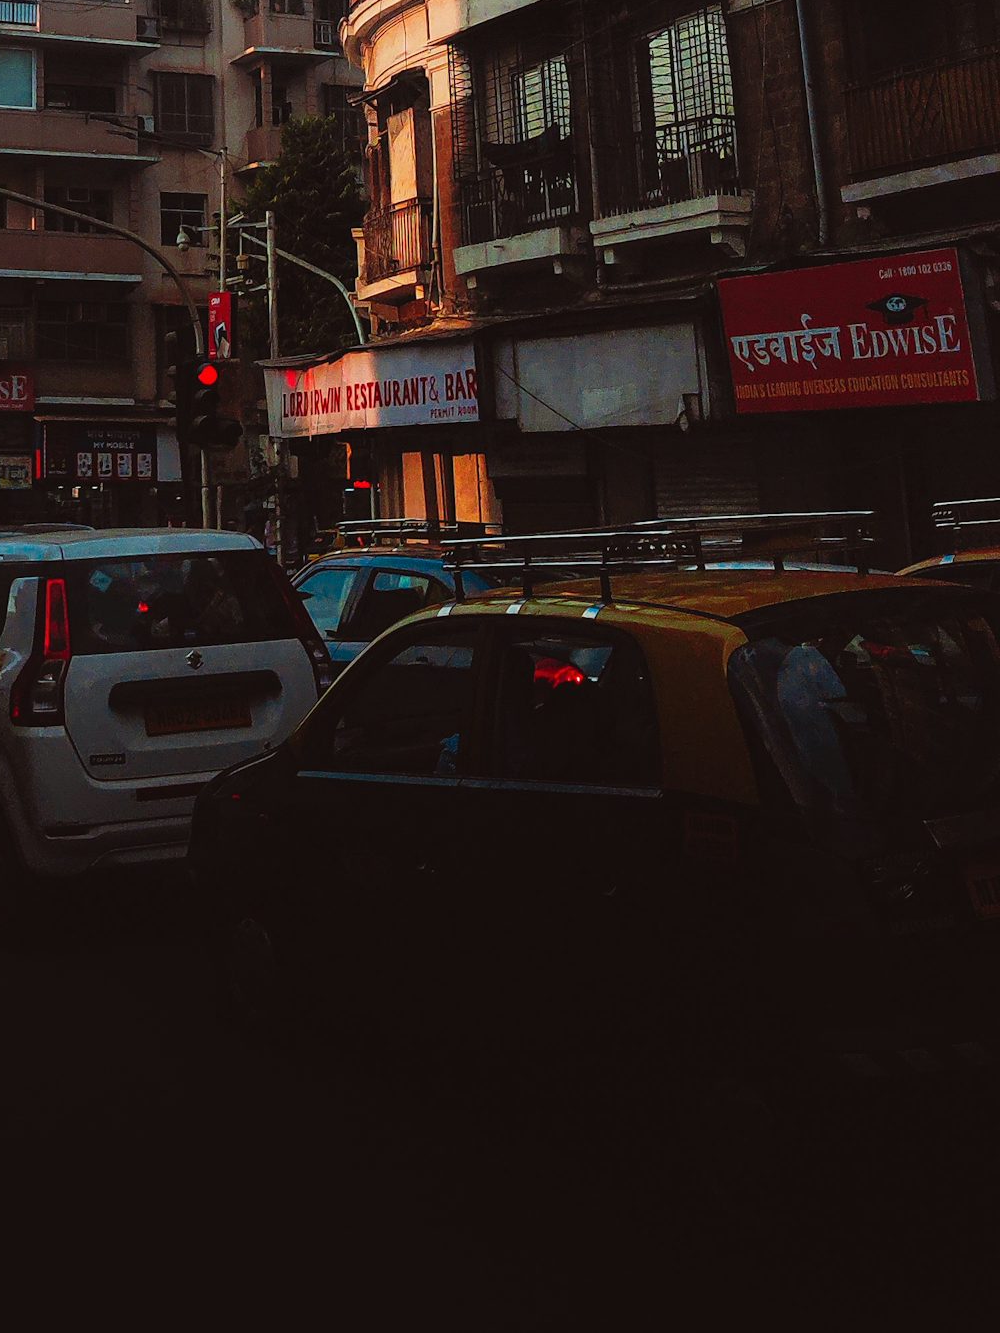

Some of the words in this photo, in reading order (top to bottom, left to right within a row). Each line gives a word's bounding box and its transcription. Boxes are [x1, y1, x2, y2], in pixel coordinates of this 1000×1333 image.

[898, 265, 917, 277] 1800
[918, 263, 932, 275] 102
[730, 313, 842, 372] एडवाईज
[846, 314, 961, 360] EDWISE
[282, 390, 309, 418] LORD
[310, 386, 342, 415] IRWIN
[345, 376, 428, 412] RESTAURANT
[428, 375, 440, 404] &
[444, 368, 479, 401] BAR
[766, 380, 802, 398] LEADING
[802, 377, 847, 396] OVERSEAS
[847, 374, 899, 394] EDUCATION
[900, 369, 970, 390] CONSULTANTS
[429, 406, 456, 419] PERMIT
[457, 405, 478, 417] ROOM
[93, 441, 105, 450] MY
[106, 441, 136, 450] MOBILE
